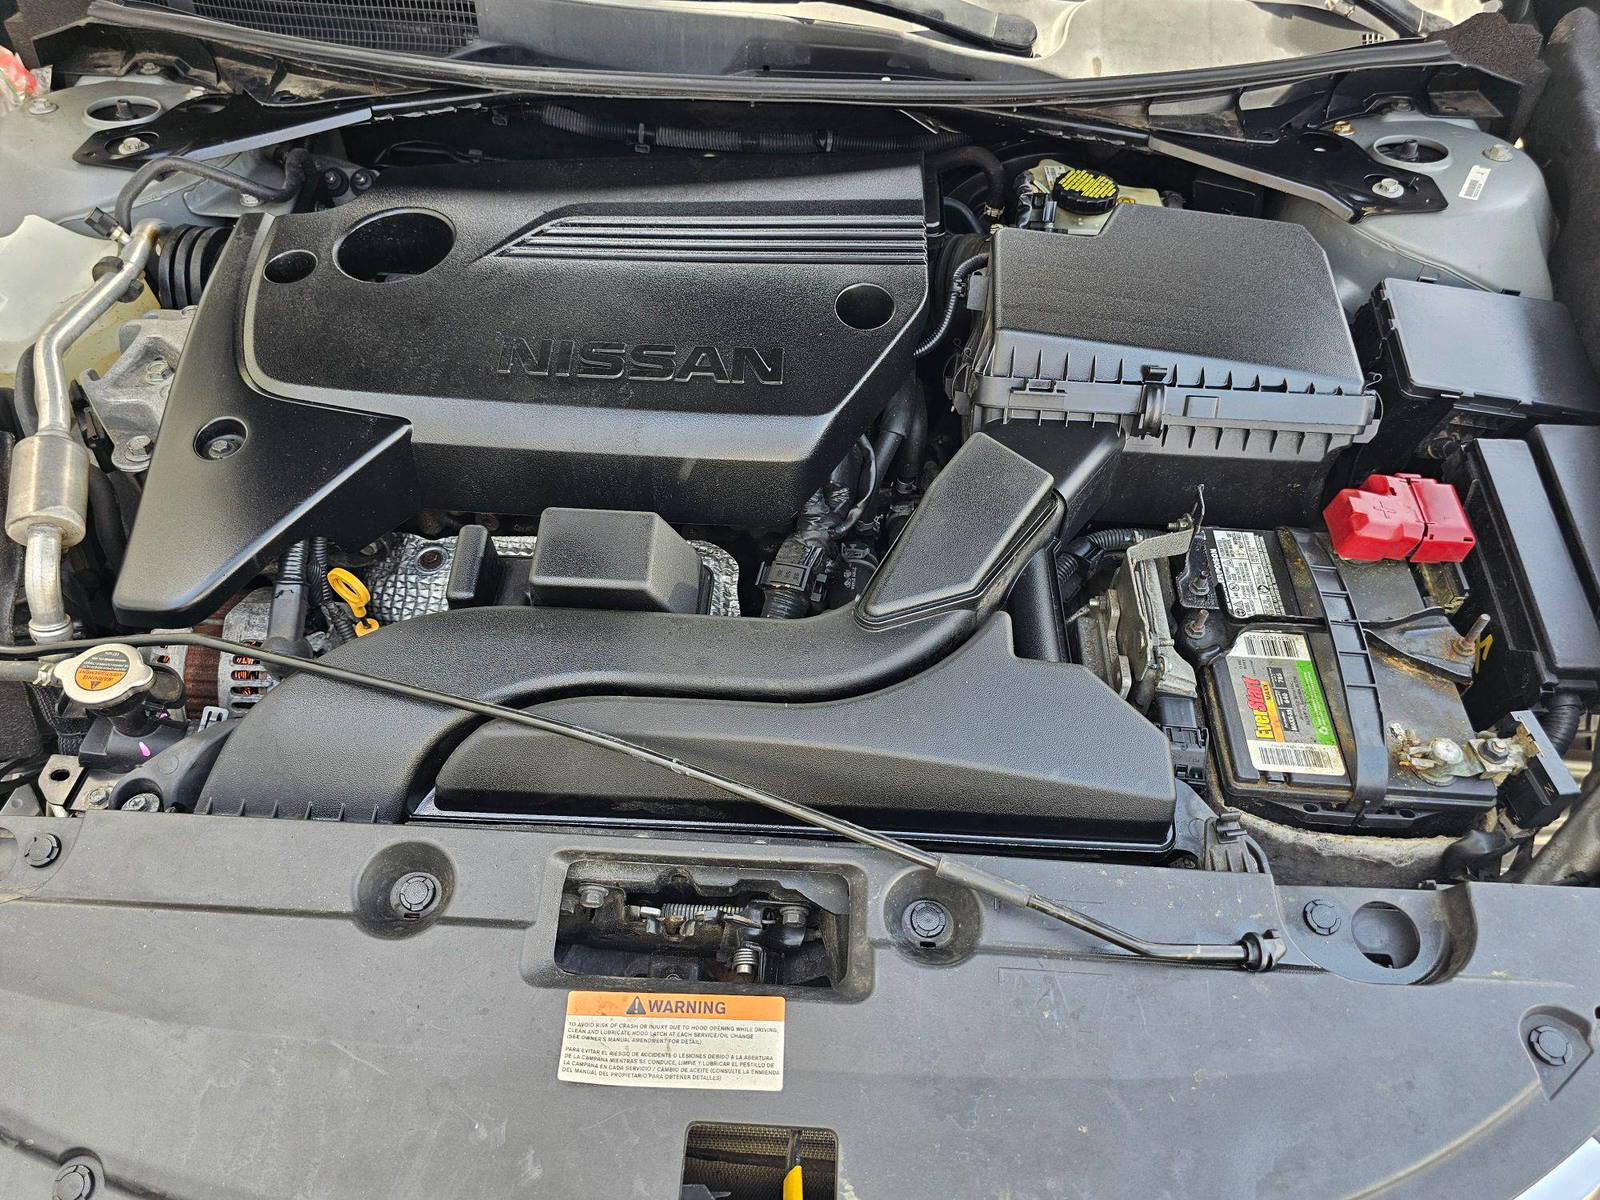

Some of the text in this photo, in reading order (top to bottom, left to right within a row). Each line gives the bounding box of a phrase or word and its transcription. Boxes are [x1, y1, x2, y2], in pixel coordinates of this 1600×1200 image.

[497, 336, 785, 385] NISSAN
[1241, 675, 1275, 739] EverStart
[648, 1000, 726, 1014] WARNING
